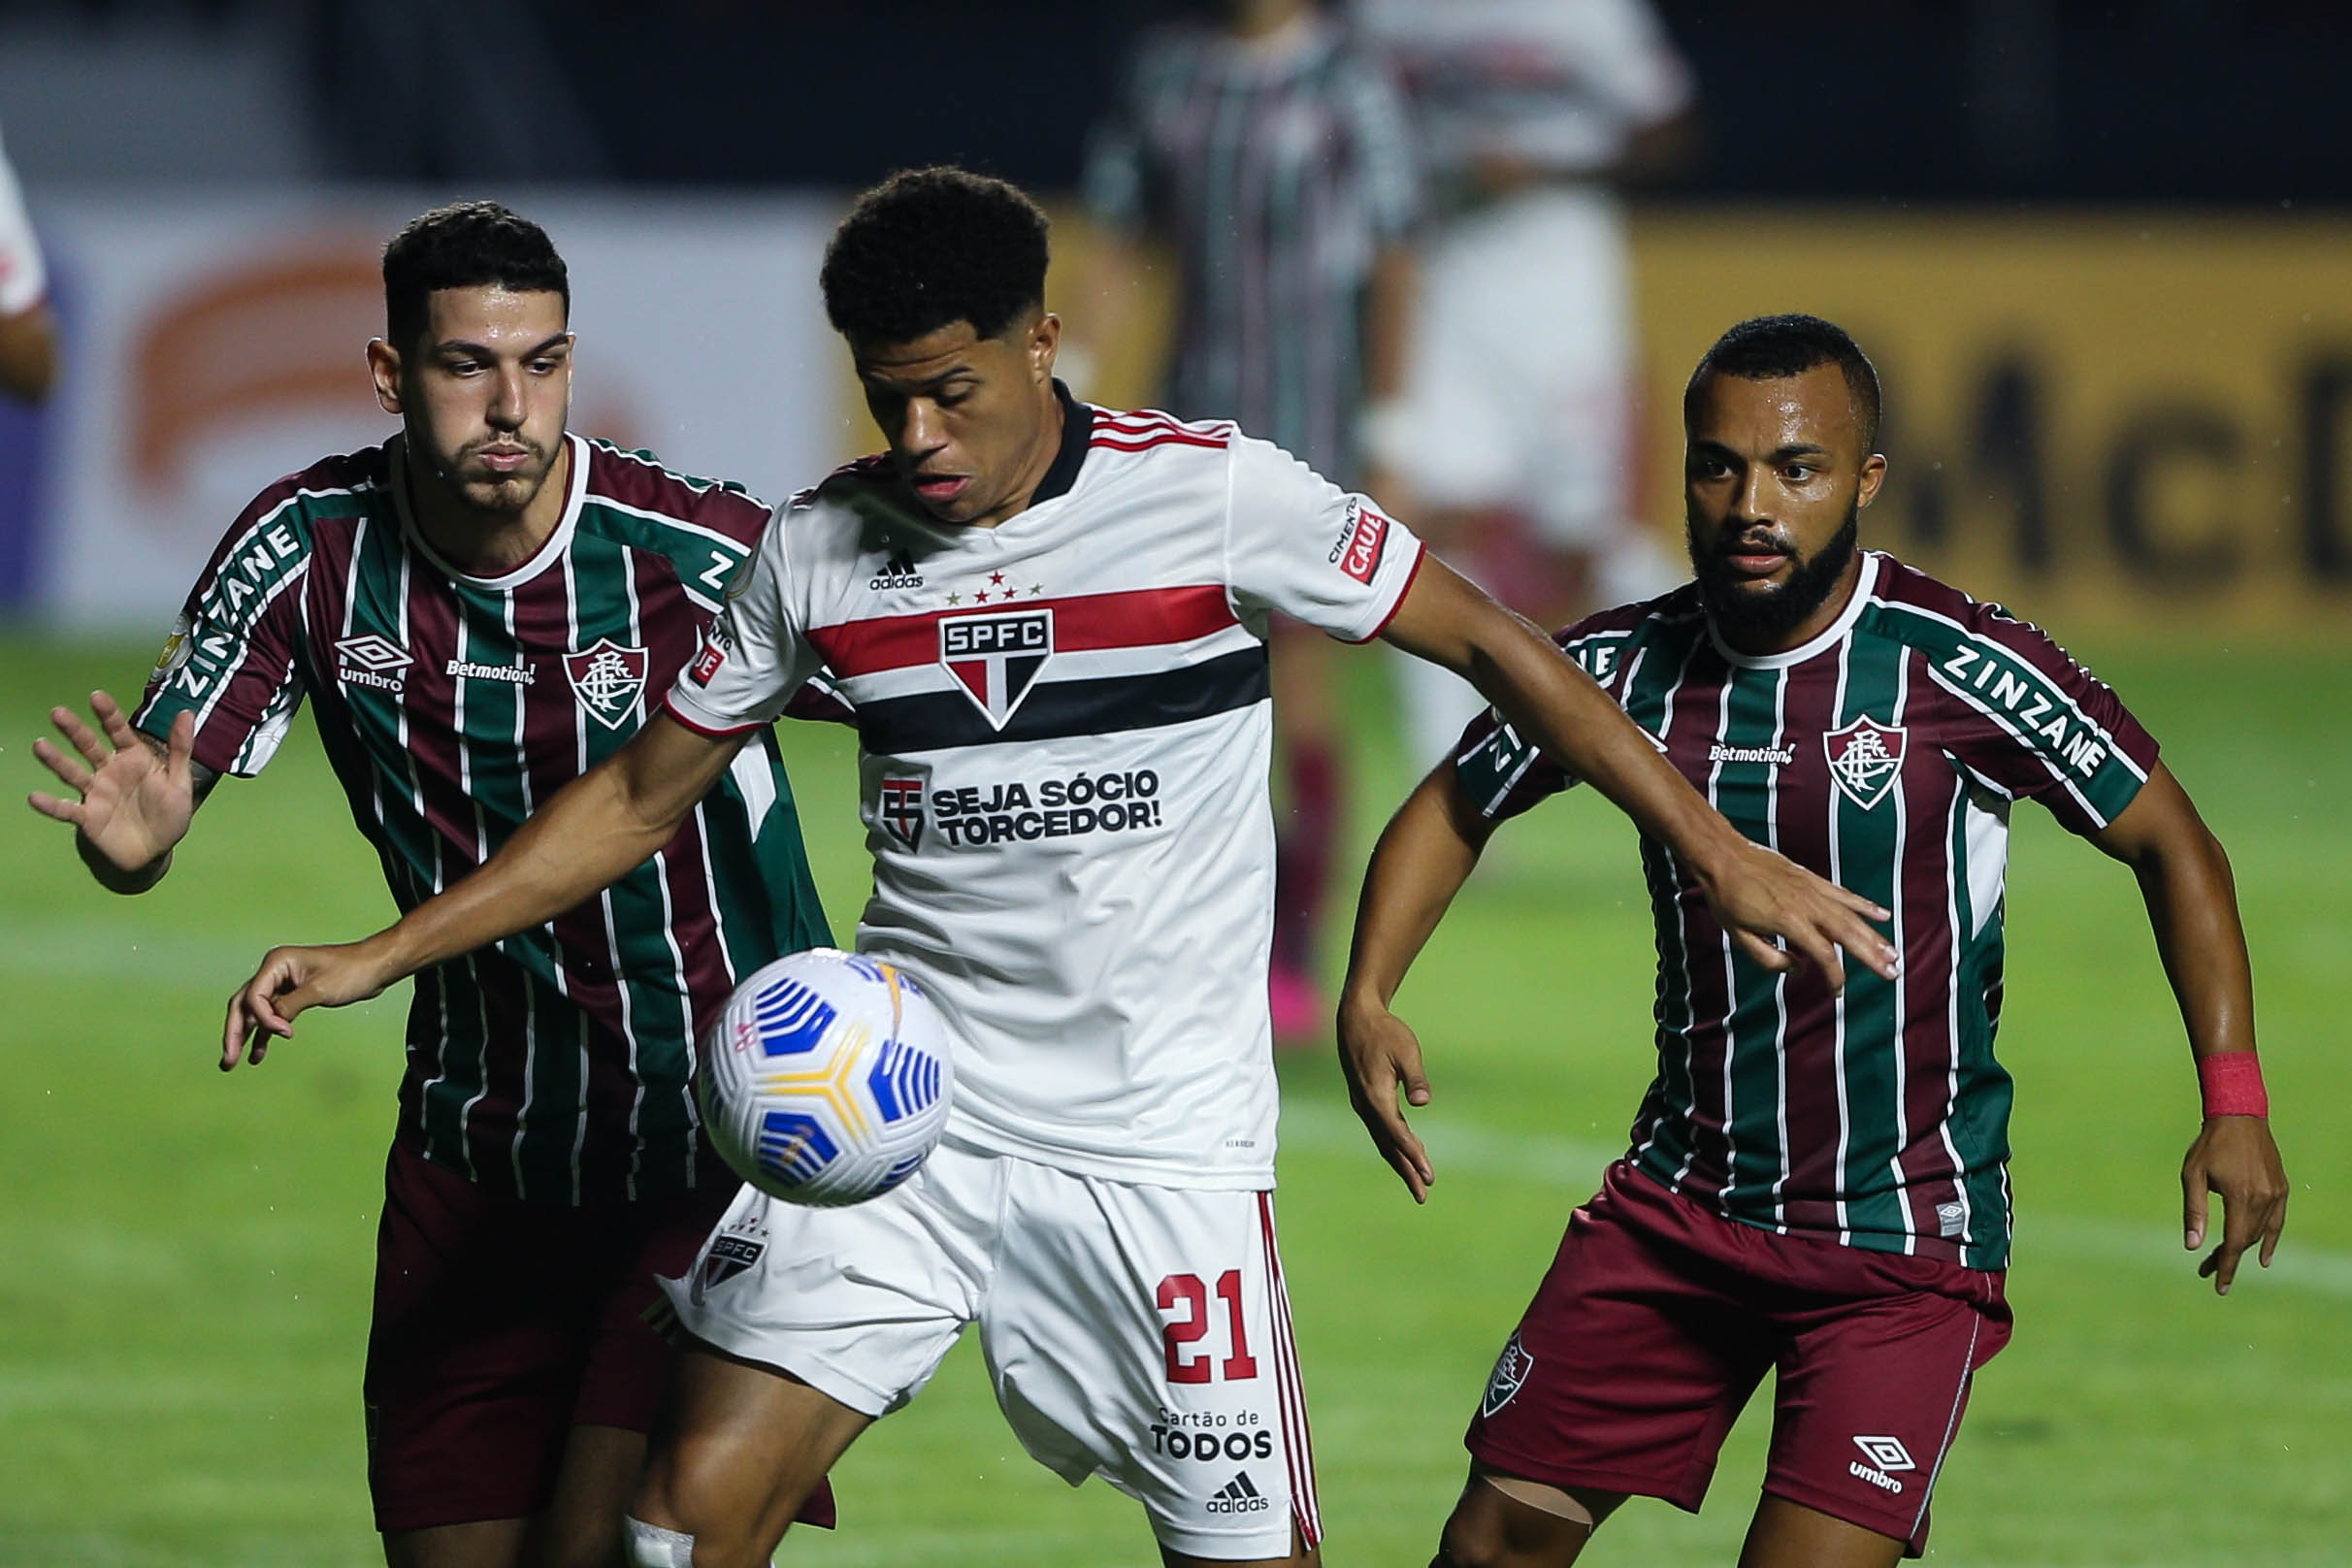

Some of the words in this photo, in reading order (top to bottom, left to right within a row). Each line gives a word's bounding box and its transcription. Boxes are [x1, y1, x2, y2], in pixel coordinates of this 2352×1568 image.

[1328, 497, 1357, 564] CIMENTO
[869, 574, 924, 591] adidas
[947, 621, 1044, 651] SPFC
[340, 668, 404, 693] umbro
[445, 659, 537, 686] Betmotion!
[1943, 644, 2107, 778] ZINZANE
[1709, 743, 1797, 765] Betmotion!
[931, 783, 1032, 818] SEJA
[1039, 769, 1160, 807] SÓCIO
[937, 800, 1163, 846] TORCEDOR!
[715, 1240, 757, 1259] SPFC
[1157, 1268, 1258, 1385] 21
[1160, 1407, 1227, 1428] Cartão
[1236, 1410, 1259, 1426] de
[1150, 1423, 1273, 1461] TODOS
[1849, 1461, 1903, 1493] umbro
[1206, 1496, 1269, 1515] adidas
